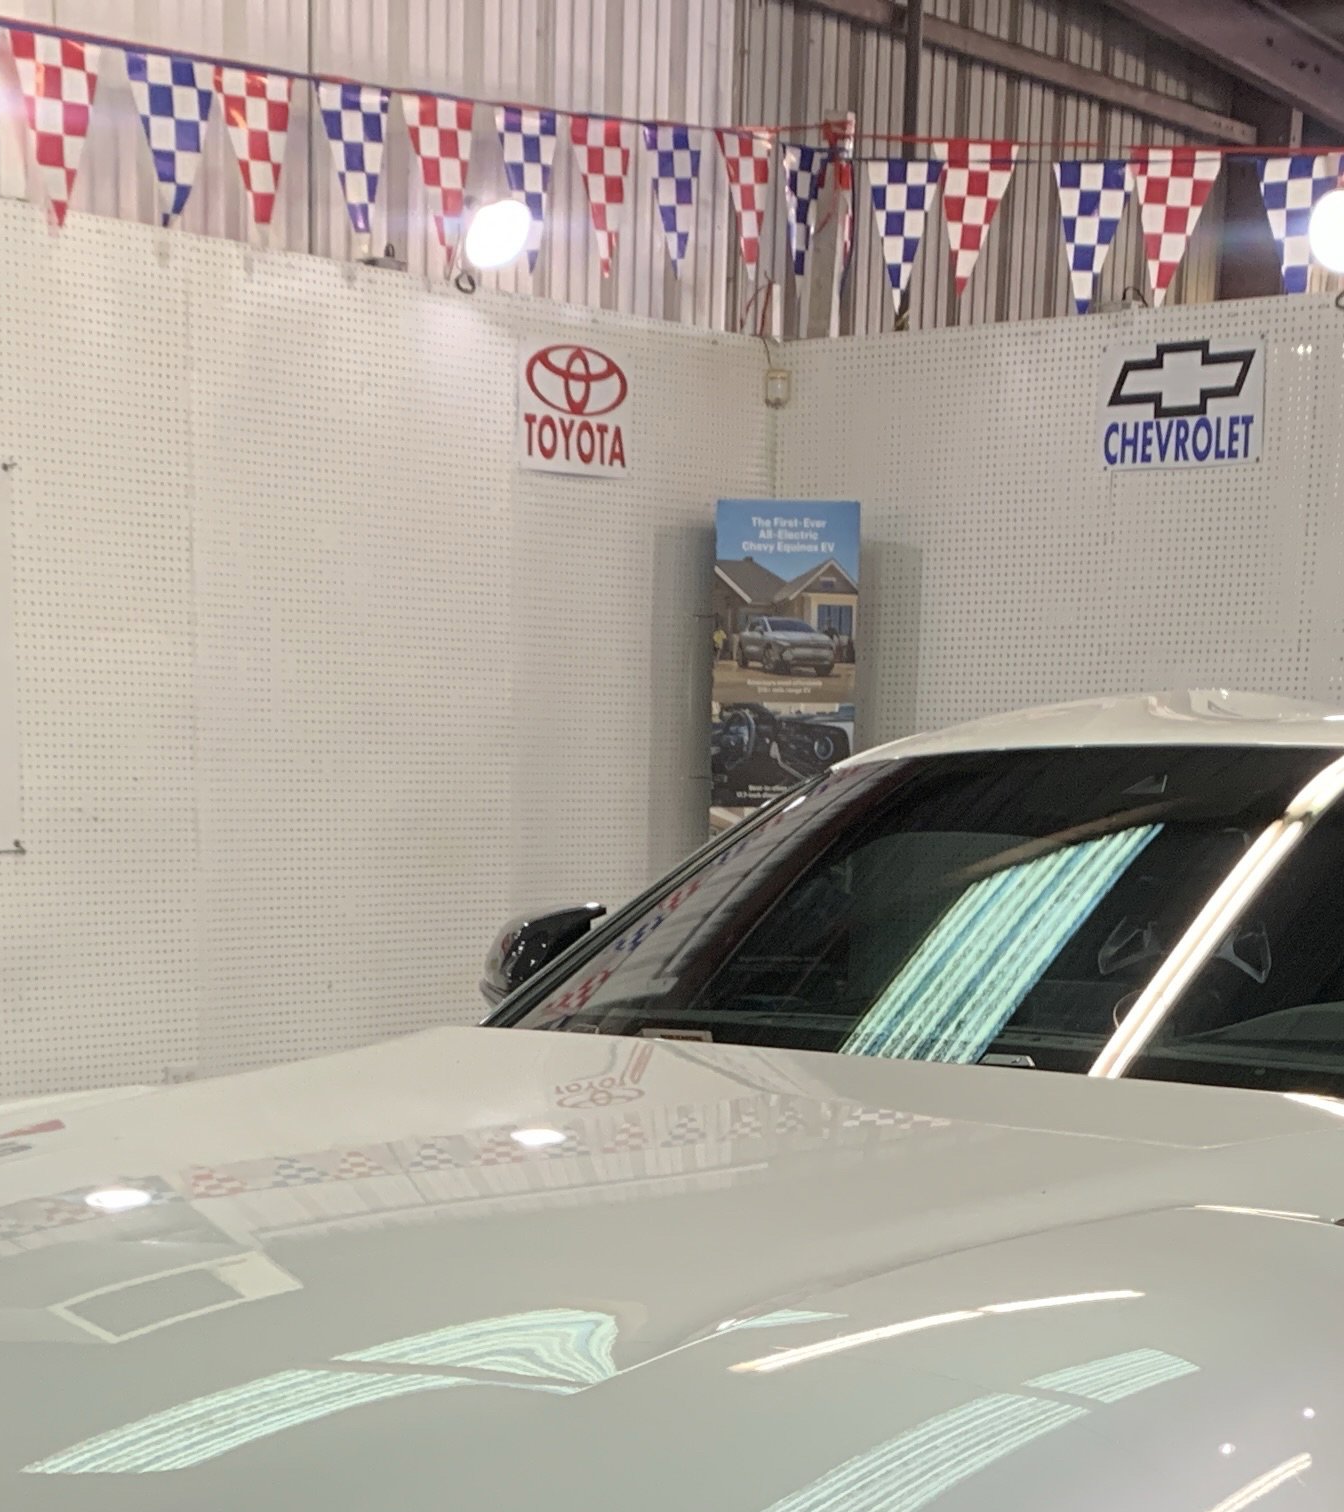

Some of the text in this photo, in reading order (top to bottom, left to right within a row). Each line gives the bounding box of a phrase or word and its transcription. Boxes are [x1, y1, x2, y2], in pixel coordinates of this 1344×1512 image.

[523, 412, 627, 469] TOYOTA
[1103, 414, 1255, 466] CHEVROLET
[751, 517, 771, 527] The
[759, 529, 819, 540] All-Electric
[742, 541, 775, 554] Chevy
[821, 542, 835, 552] EV
